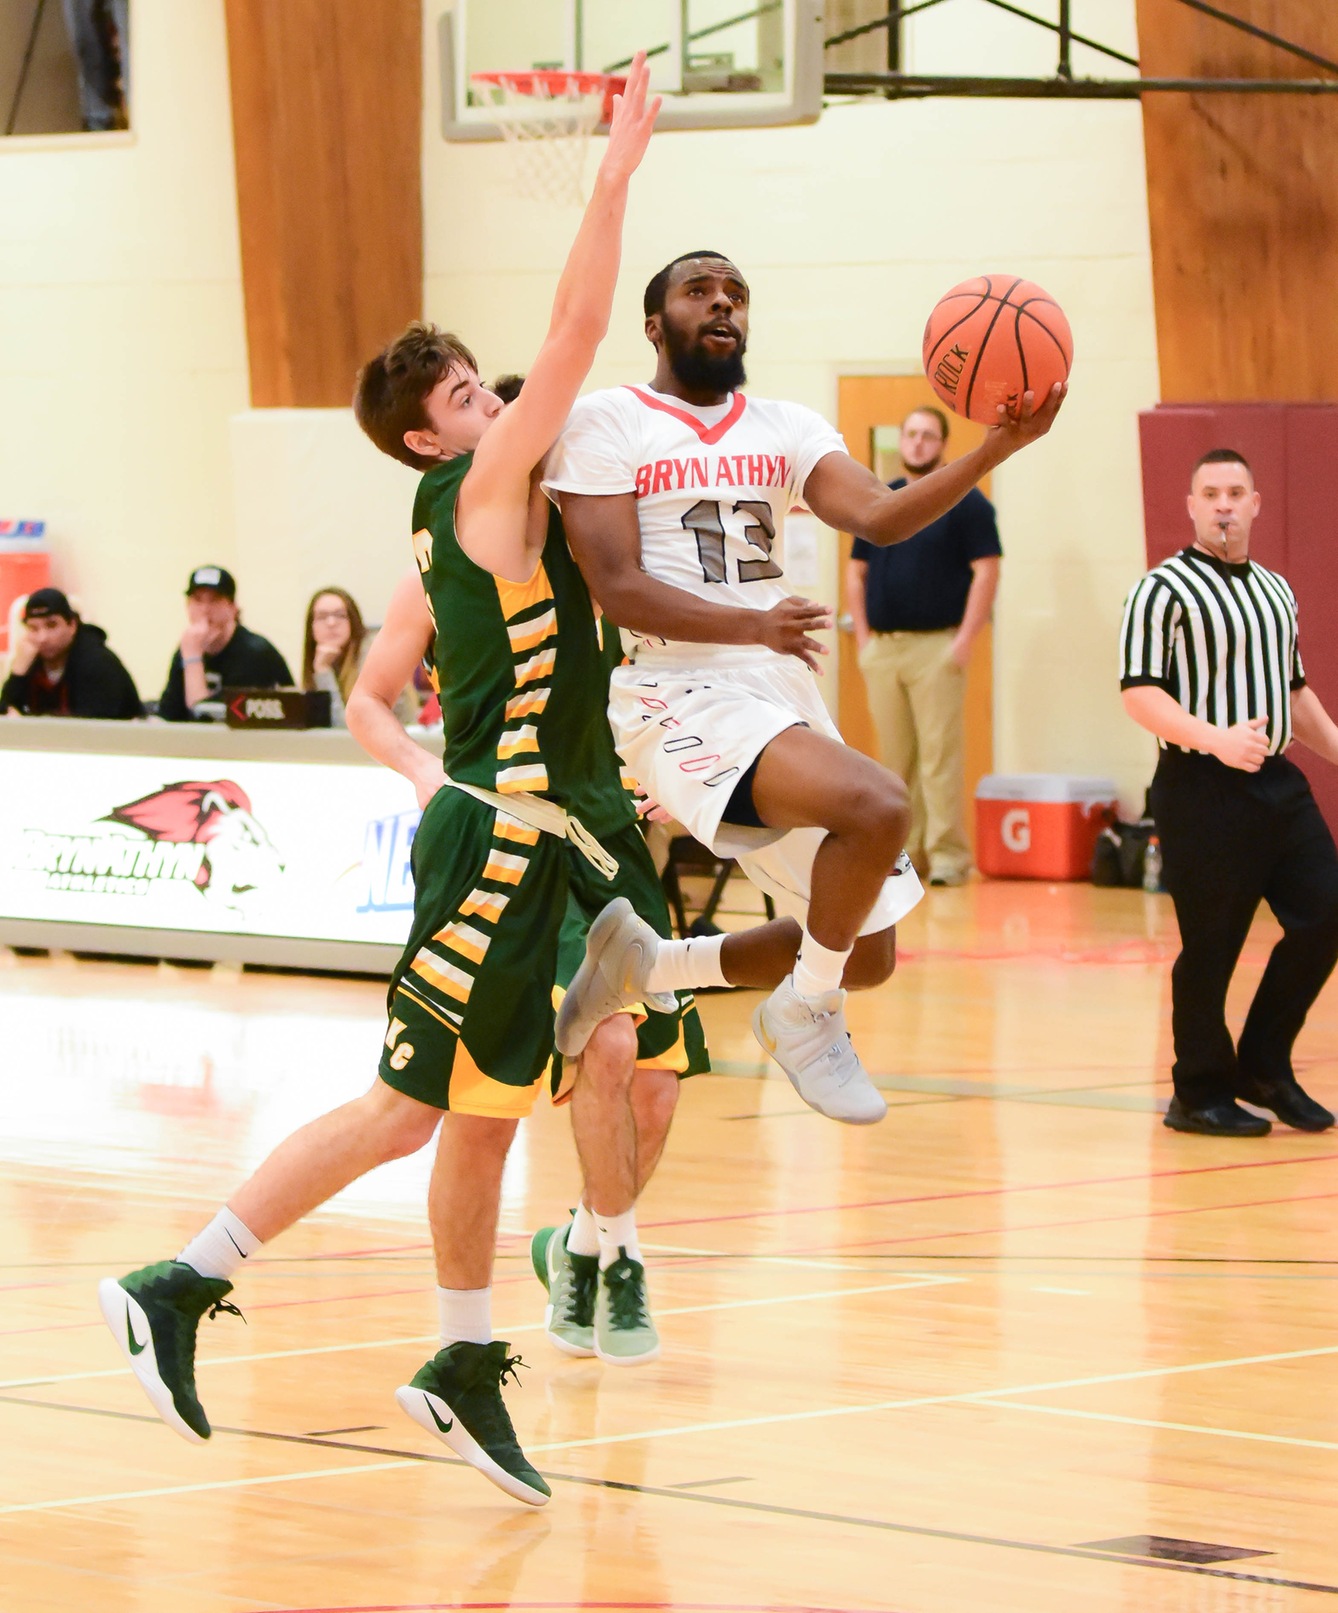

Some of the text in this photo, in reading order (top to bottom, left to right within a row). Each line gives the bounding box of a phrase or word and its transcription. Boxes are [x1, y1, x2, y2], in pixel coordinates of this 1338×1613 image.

[933, 343, 969, 396] ROCK
[635, 454, 792, 499] BRYN ATHYN
[681, 499, 784, 585] 13
[1001, 808, 1032, 854] G
